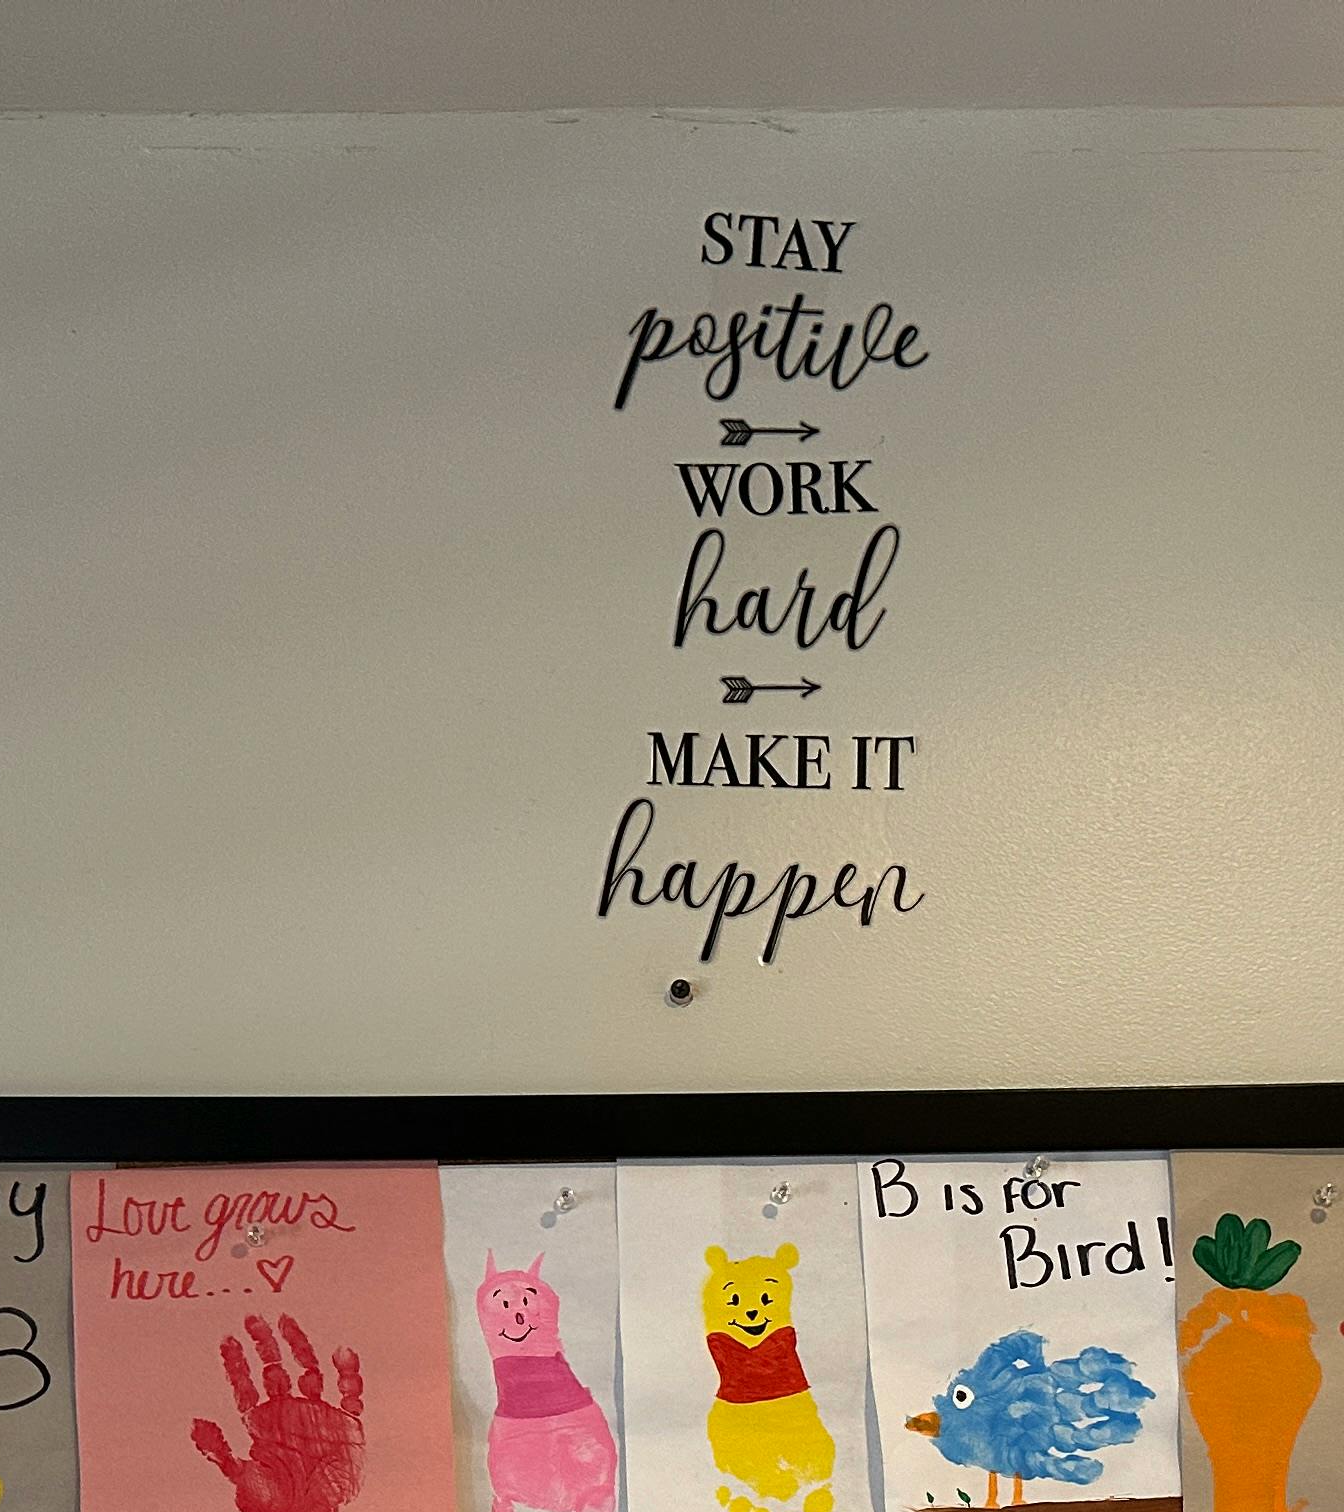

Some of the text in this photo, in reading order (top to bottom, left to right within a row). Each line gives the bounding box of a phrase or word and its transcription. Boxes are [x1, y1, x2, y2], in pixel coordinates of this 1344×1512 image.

[700, 211, 857, 273] STAY
[614, 294, 930, 410] positive
[674, 459, 879, 517] WORK
[673, 525, 900, 649] hard
[646, 732, 914, 792] MAKE IT
[597, 798, 925, 964] happen
[85, 1179, 355, 1261] Love grows
[871, 1159, 1081, 1218] B is for
[111, 1257, 250, 1301] here...
[1001, 1216, 1175, 1290] Bird!
